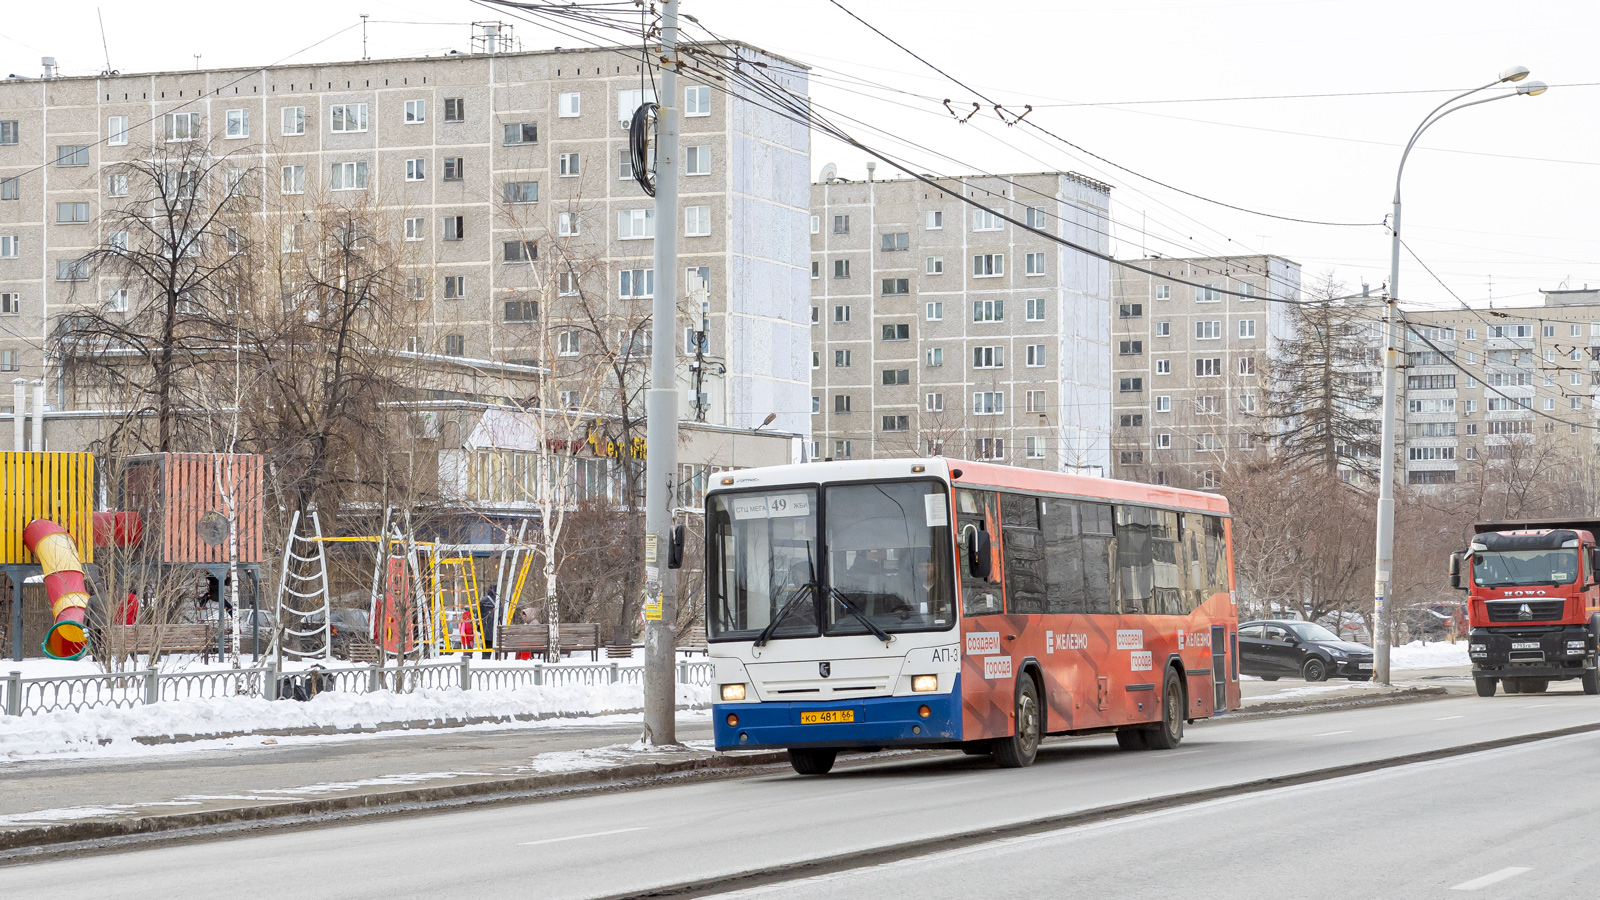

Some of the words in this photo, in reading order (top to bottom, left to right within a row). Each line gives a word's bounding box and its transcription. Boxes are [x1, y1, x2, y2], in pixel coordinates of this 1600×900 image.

[749, 504, 767, 512] МЕГА
[771, 499, 786, 511] 49
[967, 636, 999, 652] создаем
[1055, 633, 1088, 650] ЖЕЛЕЗНО
[1117, 633, 1142, 647] создаем
[1185, 632, 1210, 647] ЖЕЛЕЗНО
[932, 648, 958, 662] АП-3
[1132, 655, 1151, 670] города
[985, 660, 1011, 678] города
[820, 711, 837, 722] 481
[841, 710, 851, 719] 66
